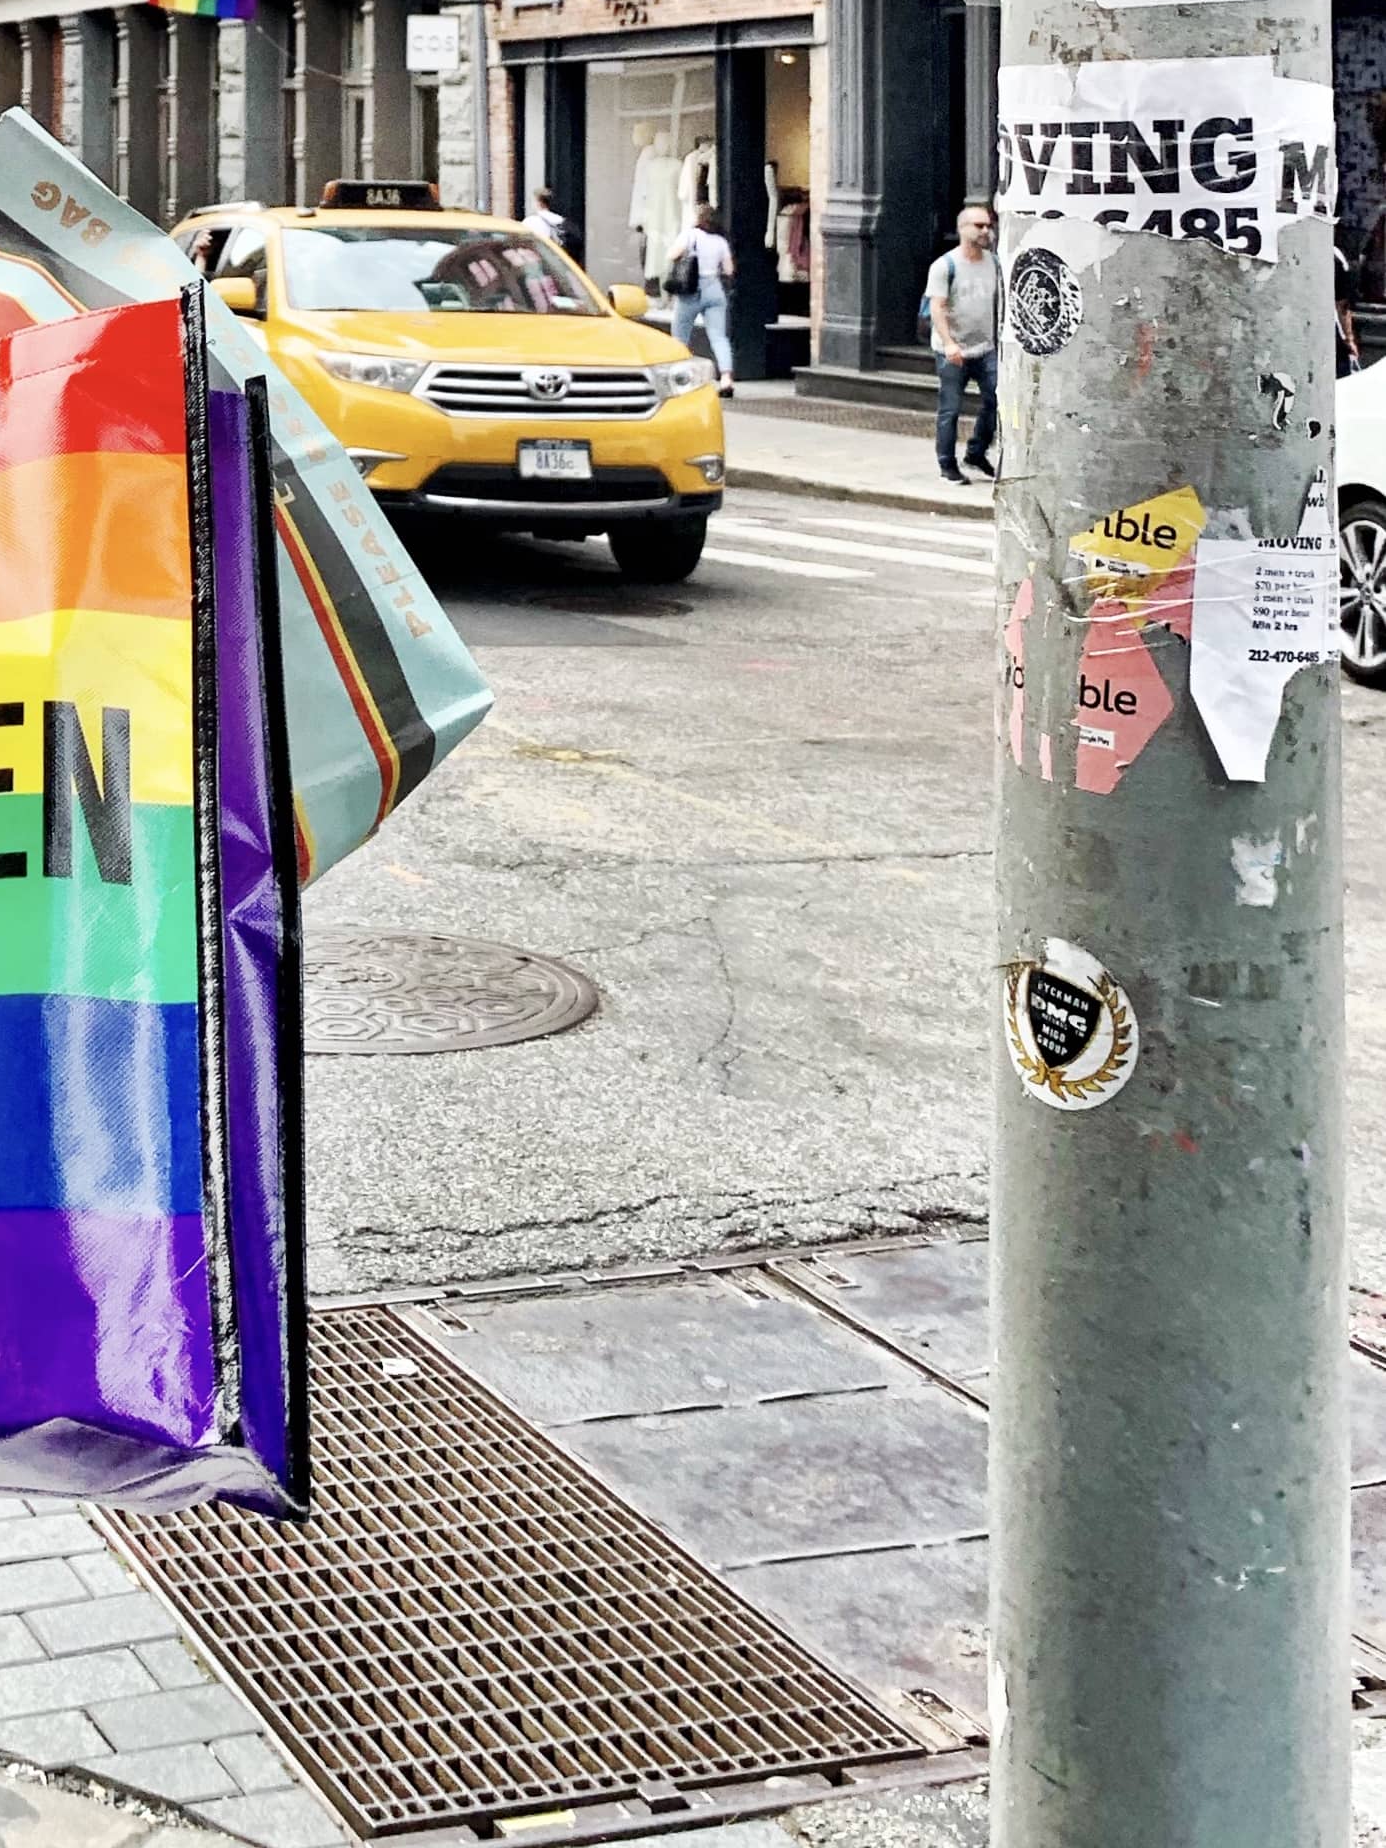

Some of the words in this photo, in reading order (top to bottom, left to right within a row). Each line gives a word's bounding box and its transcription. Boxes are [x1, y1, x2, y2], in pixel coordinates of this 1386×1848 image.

[30, 180, 113, 249] BAG
[1089, 510, 1177, 550] ible
[325, 479, 435, 640] PLEASE
[1255, 567, 1262, 576] 2
[1255, 580, 1272, 591] $70
[1253, 606, 1270, 616] $90
[1272, 608, 1289, 619] per
[1274, 622, 1282, 630] 2
[1284, 622, 1299, 631] hrs
[1248, 649, 1320, 663] 212-470-6485
[1037, 1033, 1068, 1056] GROUP
